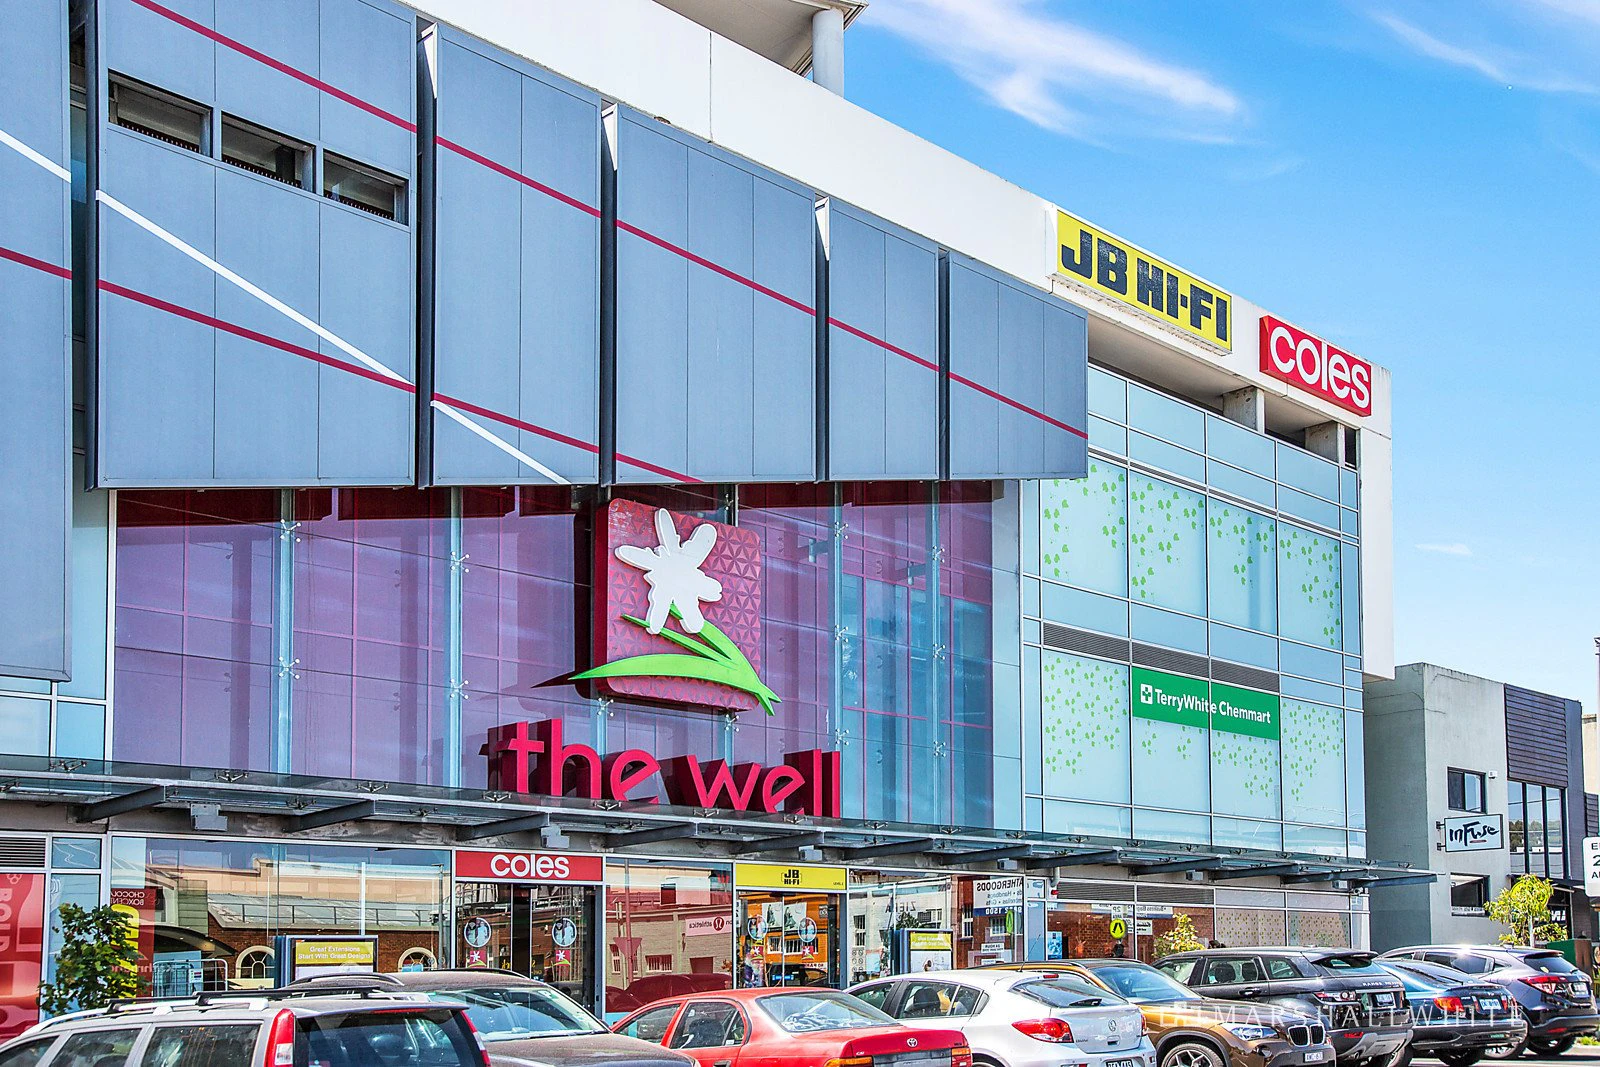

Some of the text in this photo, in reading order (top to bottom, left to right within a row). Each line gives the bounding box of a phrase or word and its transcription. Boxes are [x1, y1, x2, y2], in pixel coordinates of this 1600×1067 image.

[1061, 228, 1228, 342] JB HI-FI
[1269, 325, 1370, 409] coles
[1154, 688, 1271, 724] TerryWhite Chemmart
[507, 718, 840, 818] the well
[490, 853, 570, 879] coles
[784, 869, 800, 878] JB
